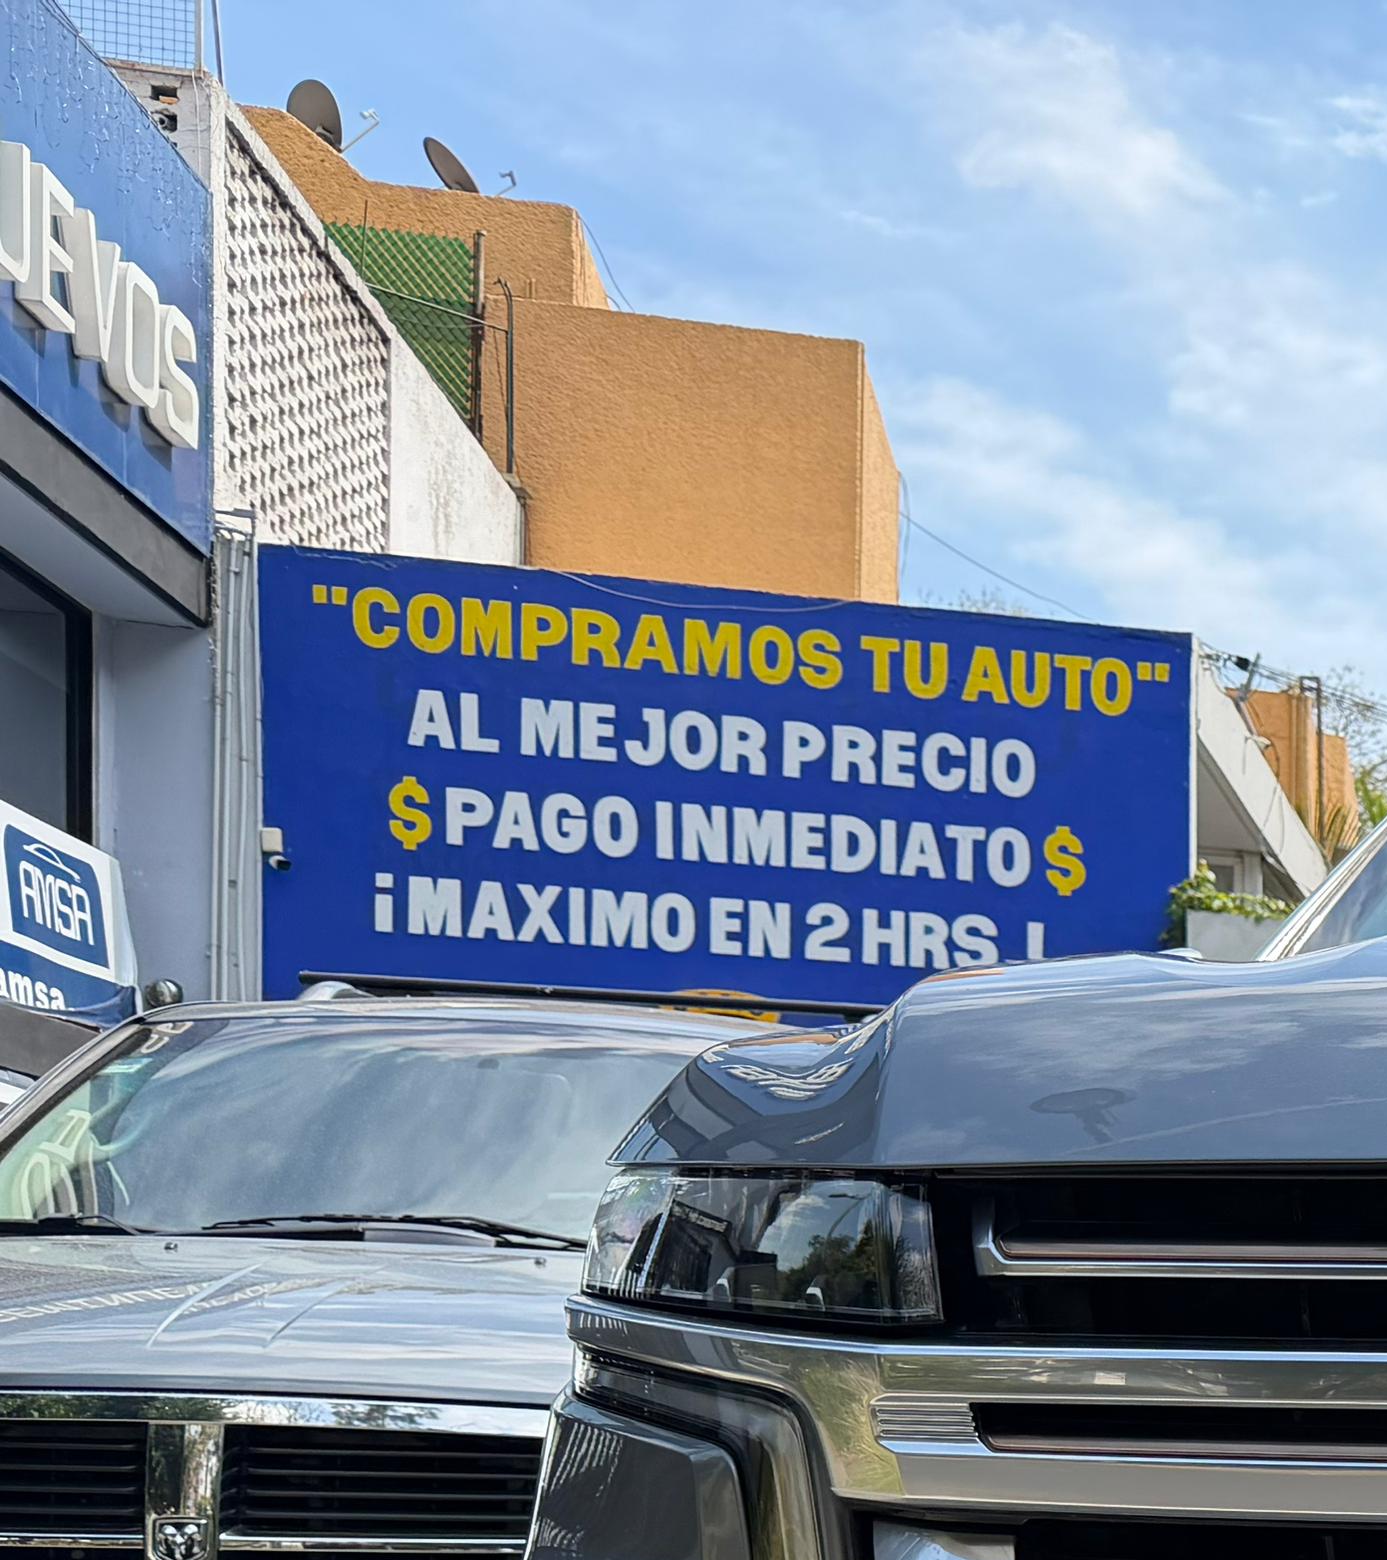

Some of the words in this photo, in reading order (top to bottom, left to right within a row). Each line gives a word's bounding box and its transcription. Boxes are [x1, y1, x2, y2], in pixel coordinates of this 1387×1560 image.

[312, 585, 843, 690] "COMPRAMOS
[860, 635, 949, 700] TU
[961, 646, 1170, 717] AUTO"
[407, 689, 500, 754] AL
[520, 697, 767, 776] MEJOR
[782, 715, 1036, 798] PRECIO
[445, 787, 639, 858] PAGO
[655, 801, 1031, 887] INMEDIATO
[19, 859, 95, 946] AMSA
[710, 897, 791, 959] EN
[804, 902, 851, 963] 2
[862, 908, 1000, 969] HRS
